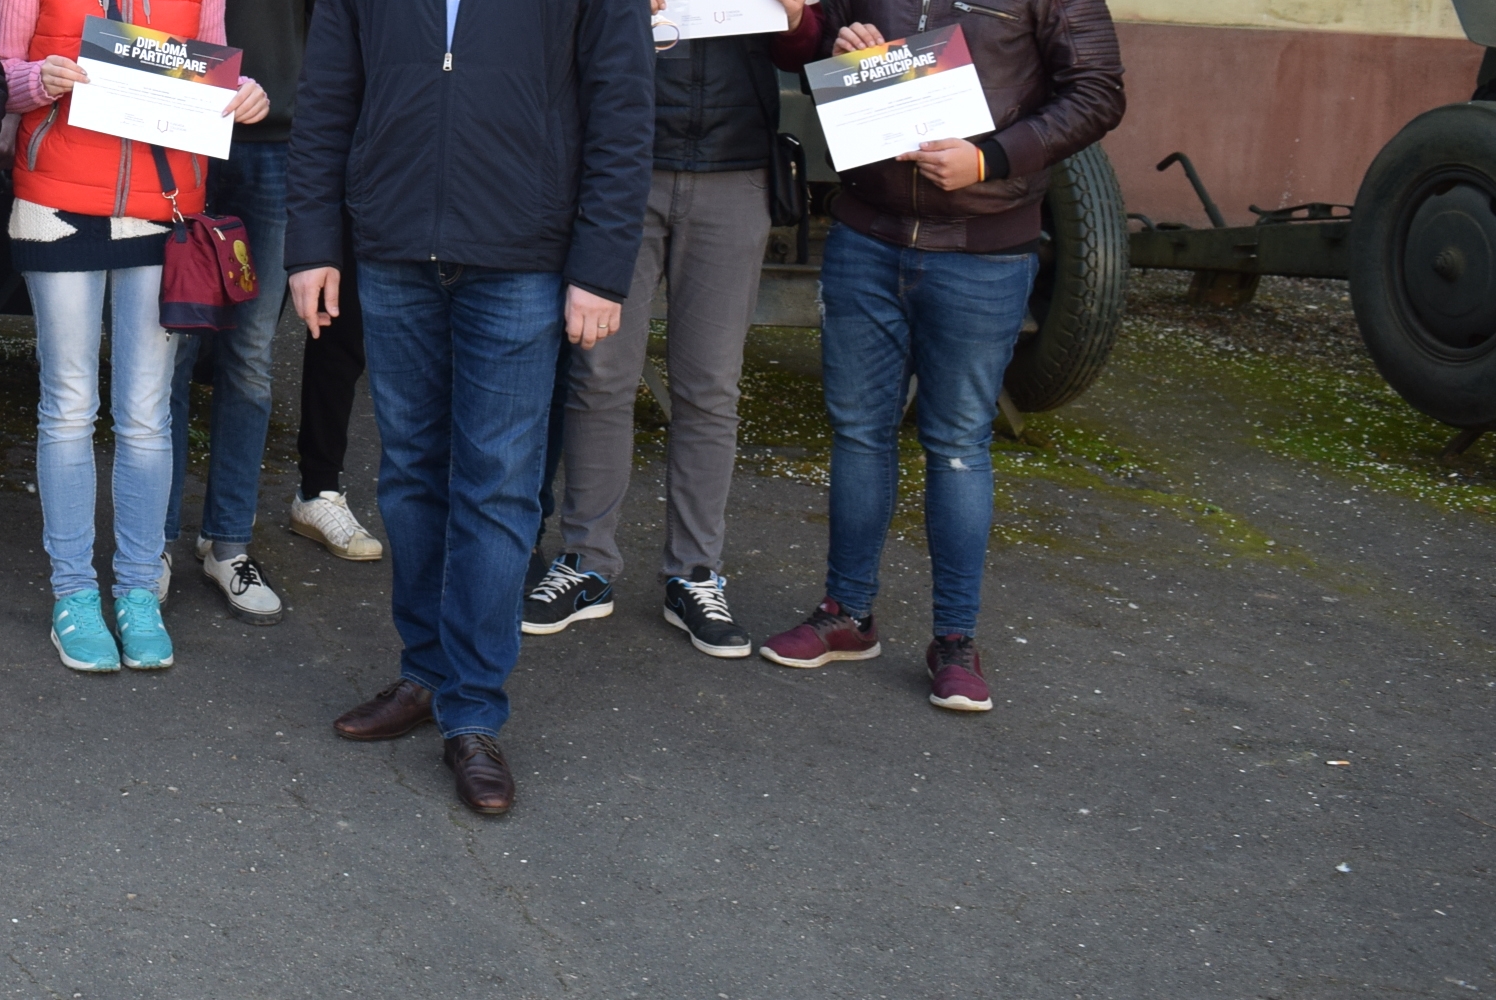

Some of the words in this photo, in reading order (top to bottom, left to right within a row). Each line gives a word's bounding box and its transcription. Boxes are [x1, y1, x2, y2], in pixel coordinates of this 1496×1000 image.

[114, 42, 130, 56] DE
[132, 47, 207, 73] PARTICIPARE
[137, 36, 188, 58] DIPLOMĂ
[859, 44, 913, 71] DIPLOMĂ
[843, 71, 861, 87] DE
[860, 52, 937, 82] PARTICIPARE
